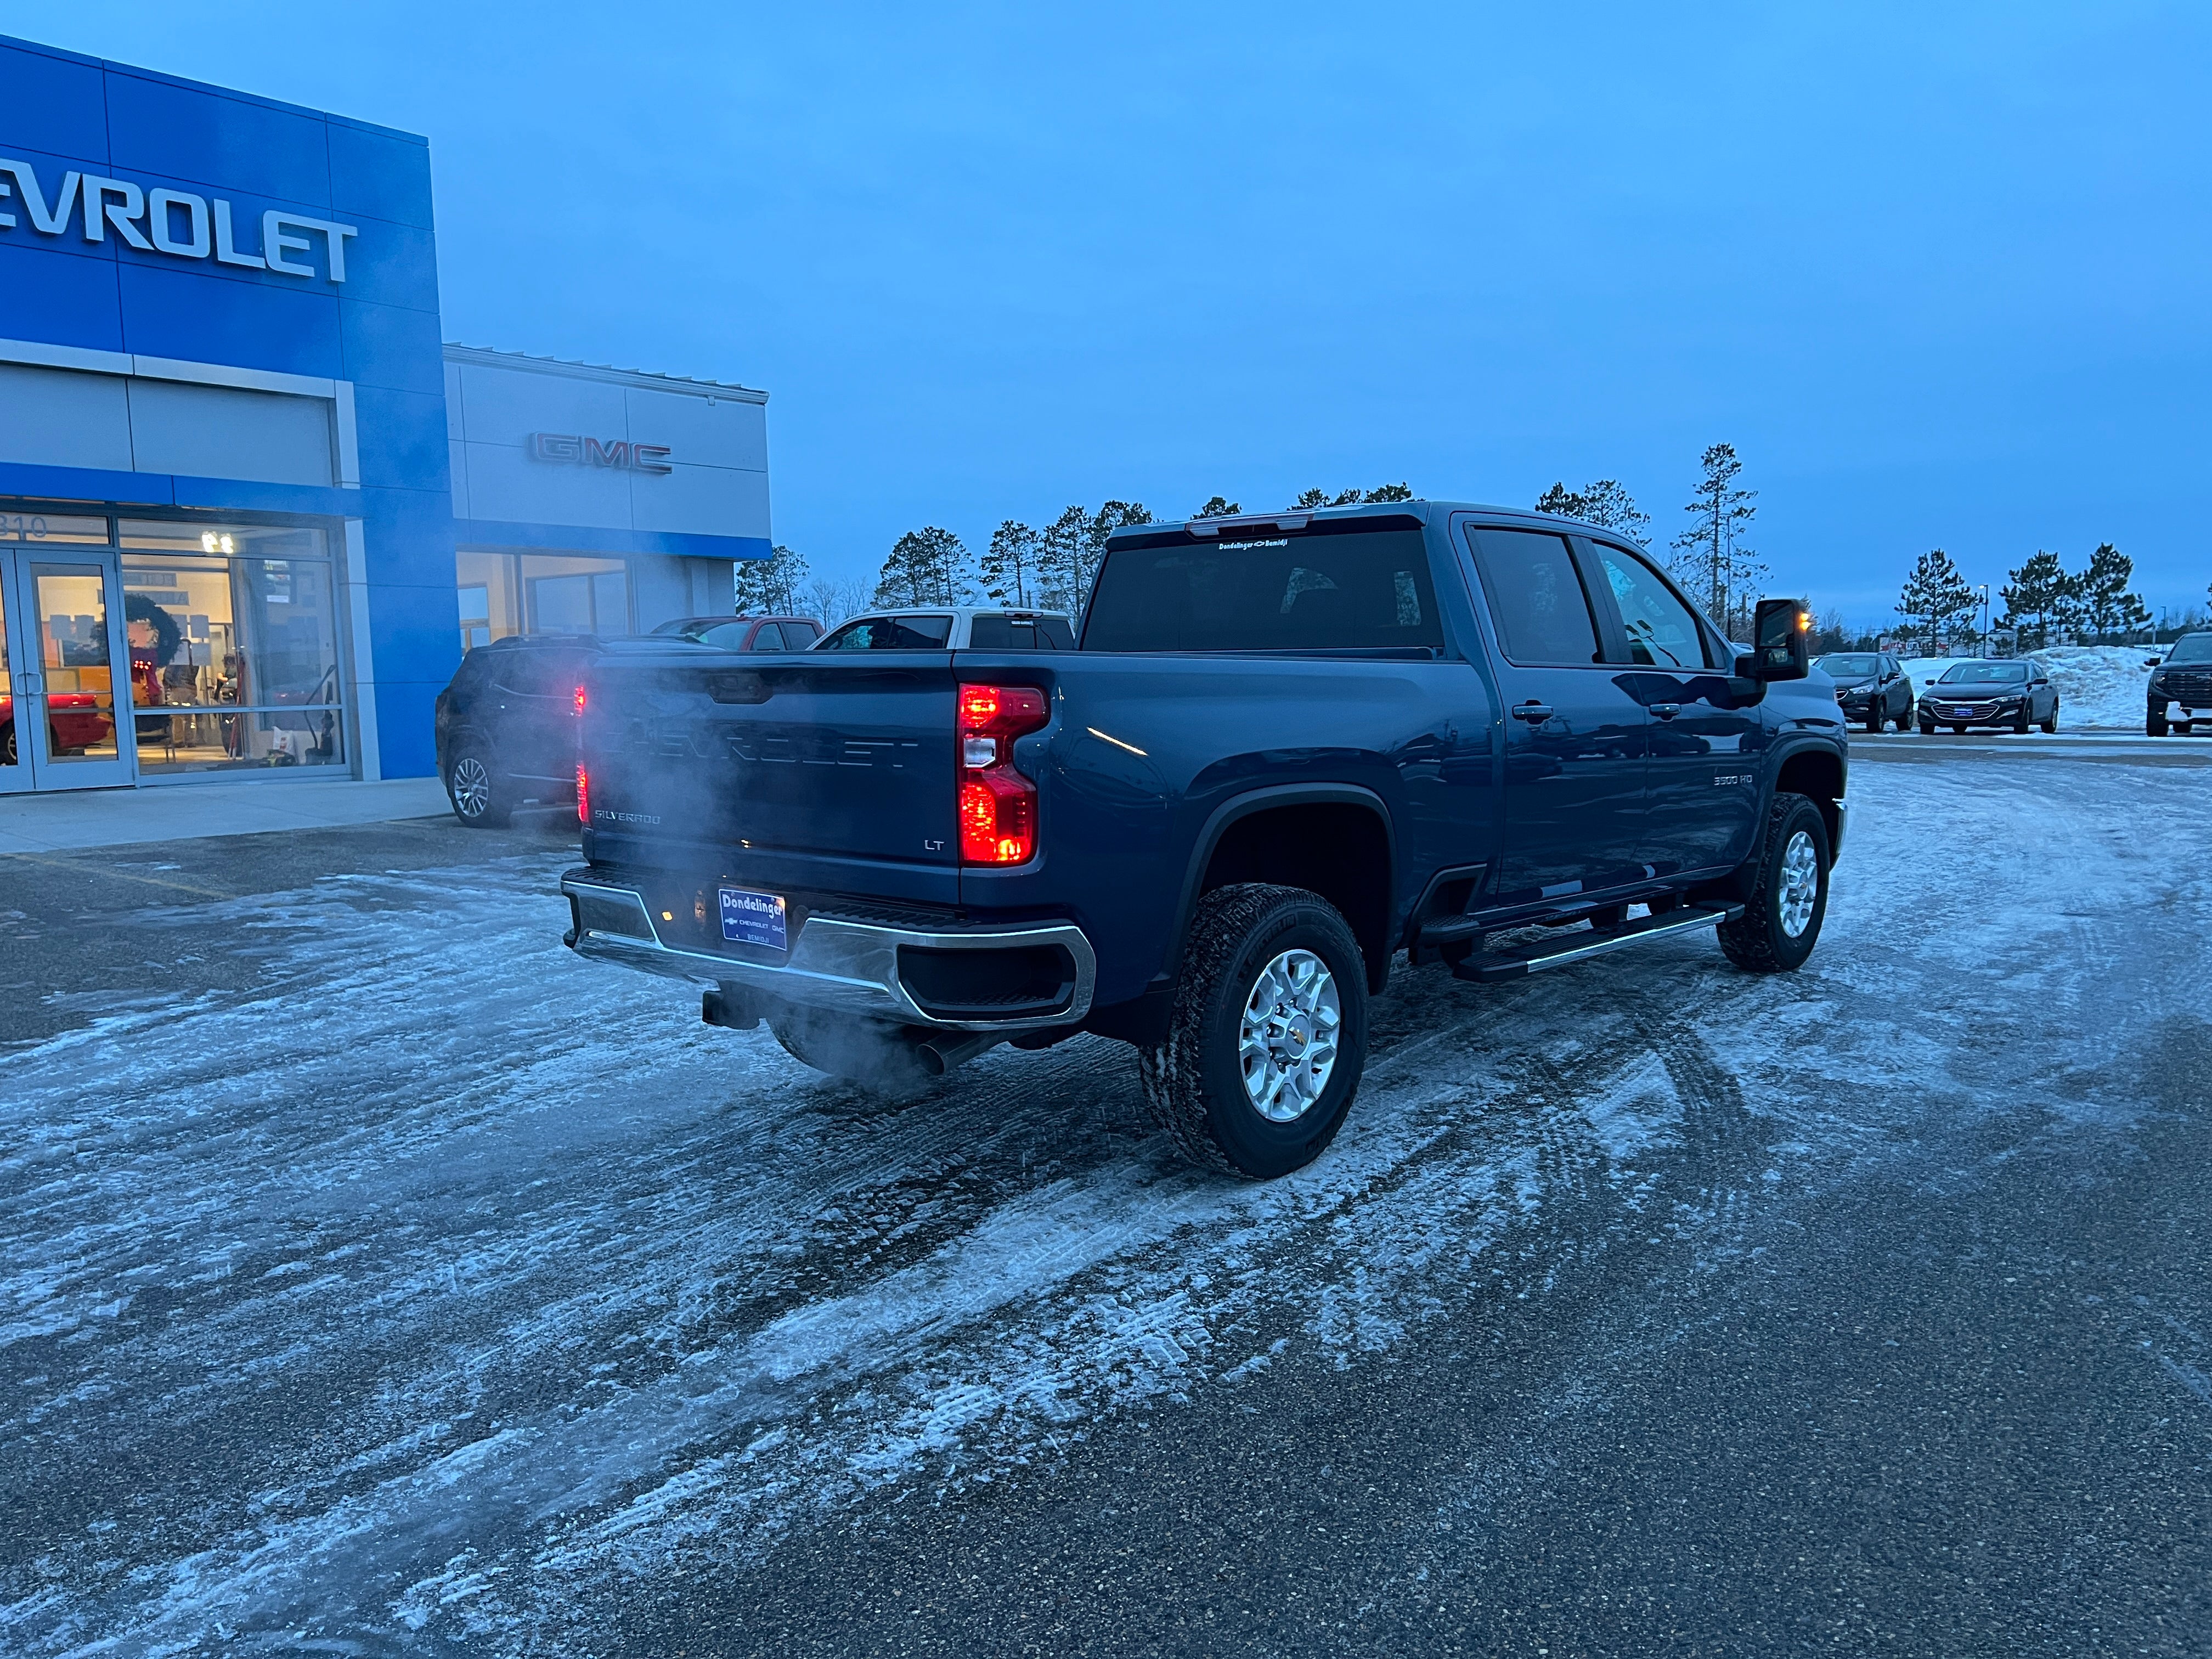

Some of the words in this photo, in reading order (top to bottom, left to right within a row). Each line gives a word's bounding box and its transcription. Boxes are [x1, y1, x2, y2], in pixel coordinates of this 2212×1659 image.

[529, 432, 673, 474] GMC
[1218, 542, 1254, 550] Dondelinger
[1265, 539, 1288, 547] Bemidji
[1714, 776, 1738, 786] 3500
[1740, 775, 1753, 783] HD
[595, 810, 661, 825] SILVERADO
[924, 840, 944, 850] LT
[722, 894, 782, 919] Dondelinger
[739, 919, 769, 929] CHEVROLET
[772, 925, 785, 934] GMC
[747, 934, 769, 944] BEMIDJI
